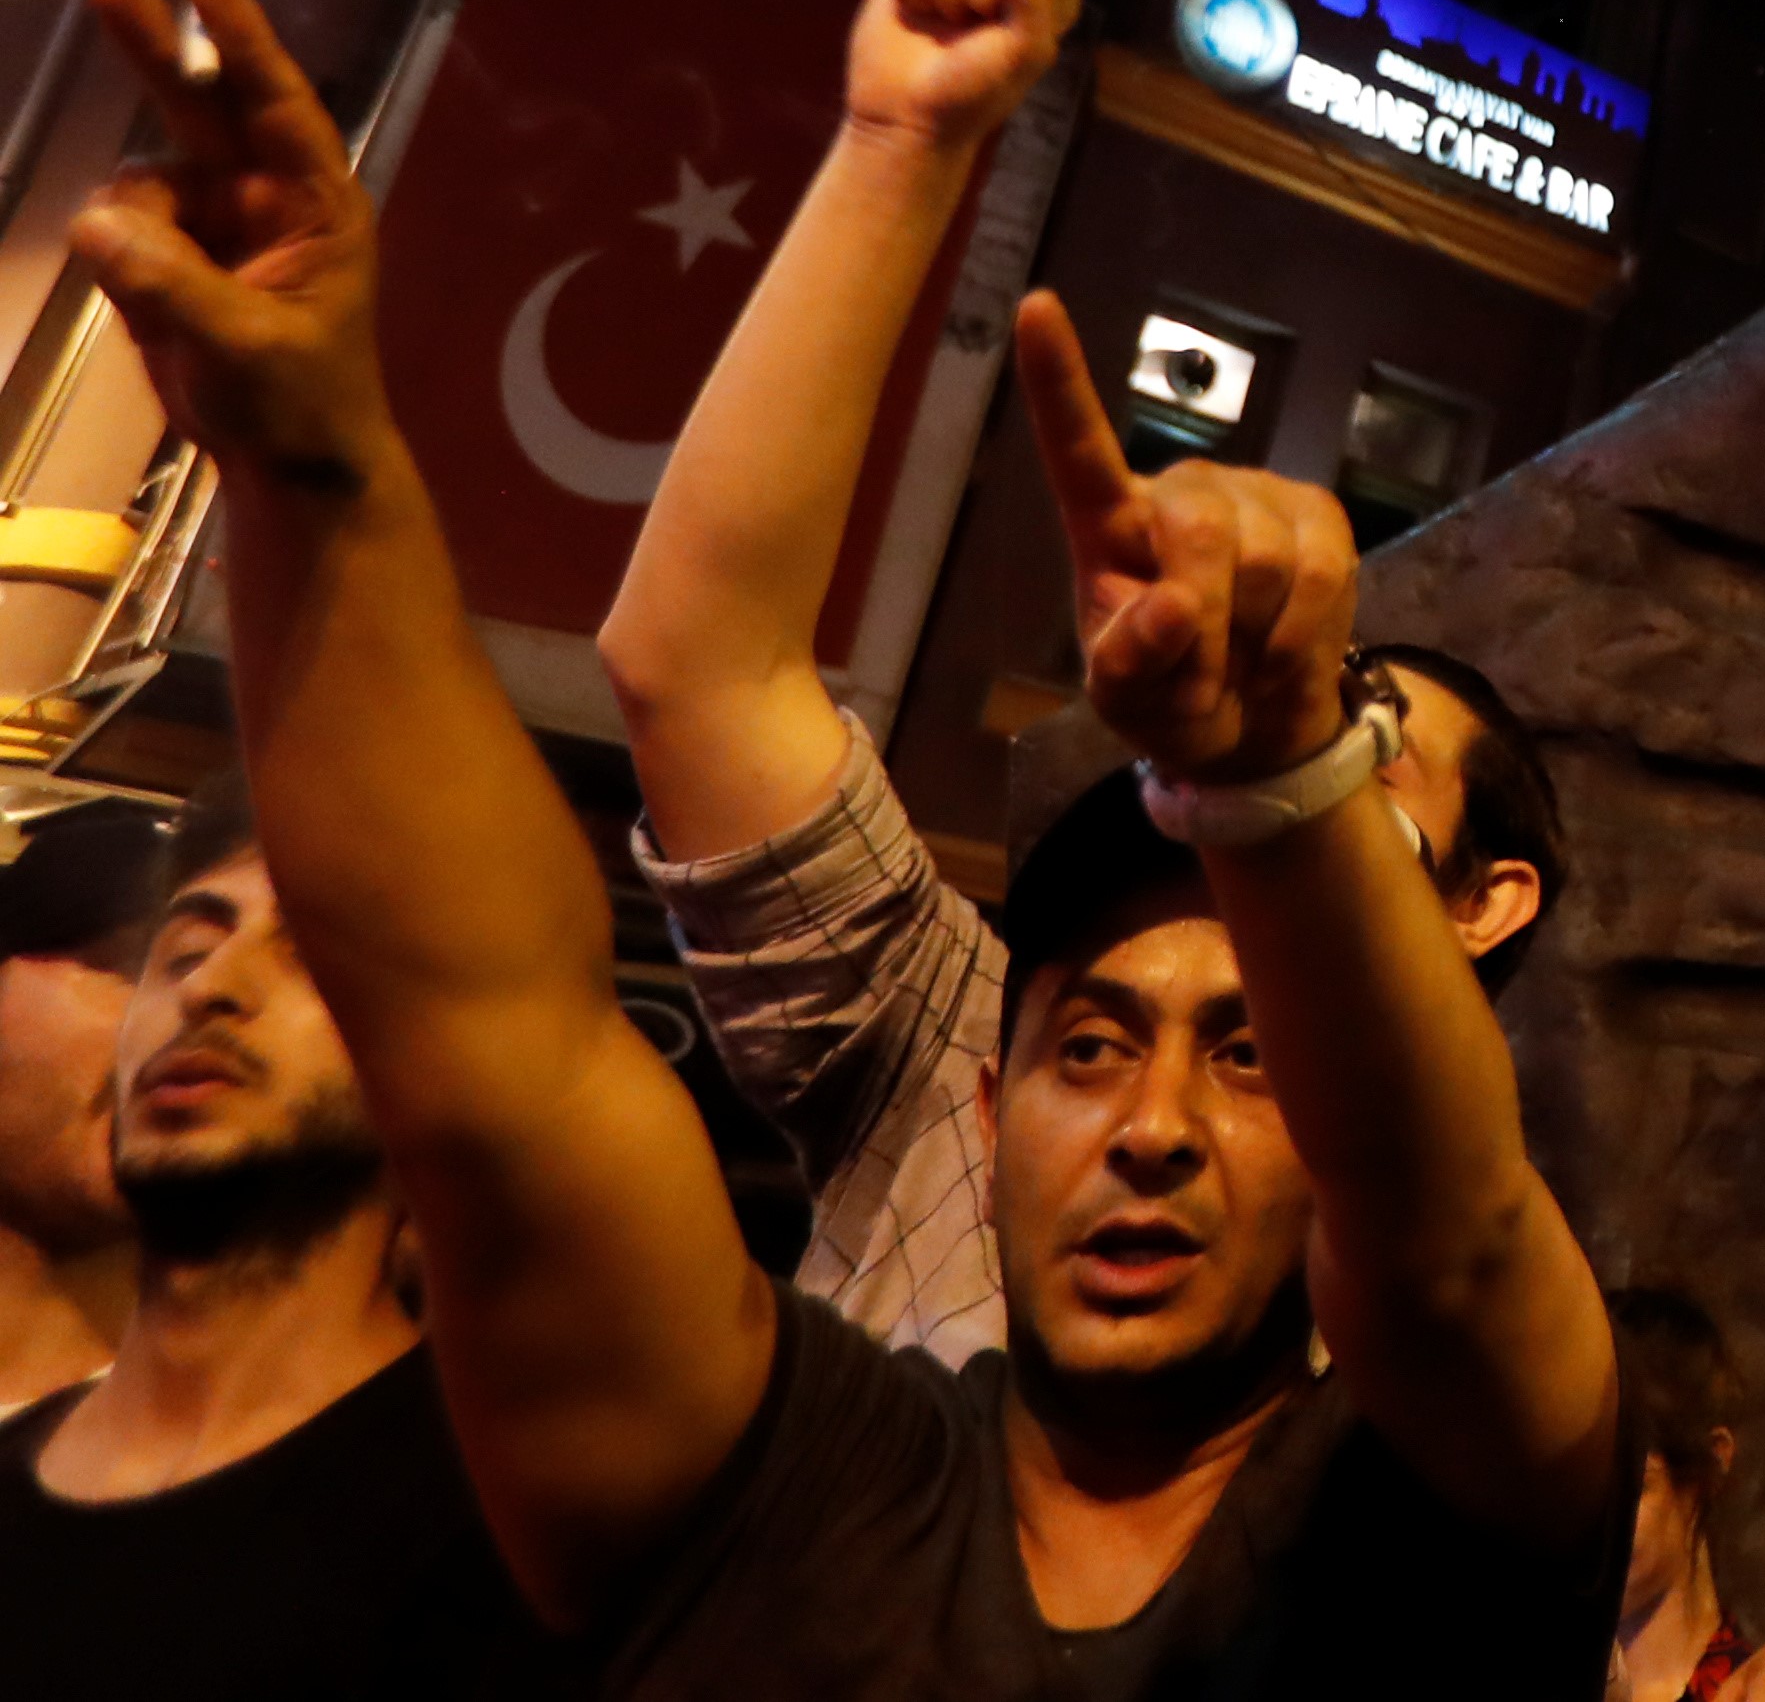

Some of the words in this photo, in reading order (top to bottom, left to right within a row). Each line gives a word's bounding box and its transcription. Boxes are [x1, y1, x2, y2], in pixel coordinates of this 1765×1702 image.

[1425, 116, 1520, 192] CAFE
[1514, 156, 1546, 205] &
[1545, 166, 1615, 233] BAR
